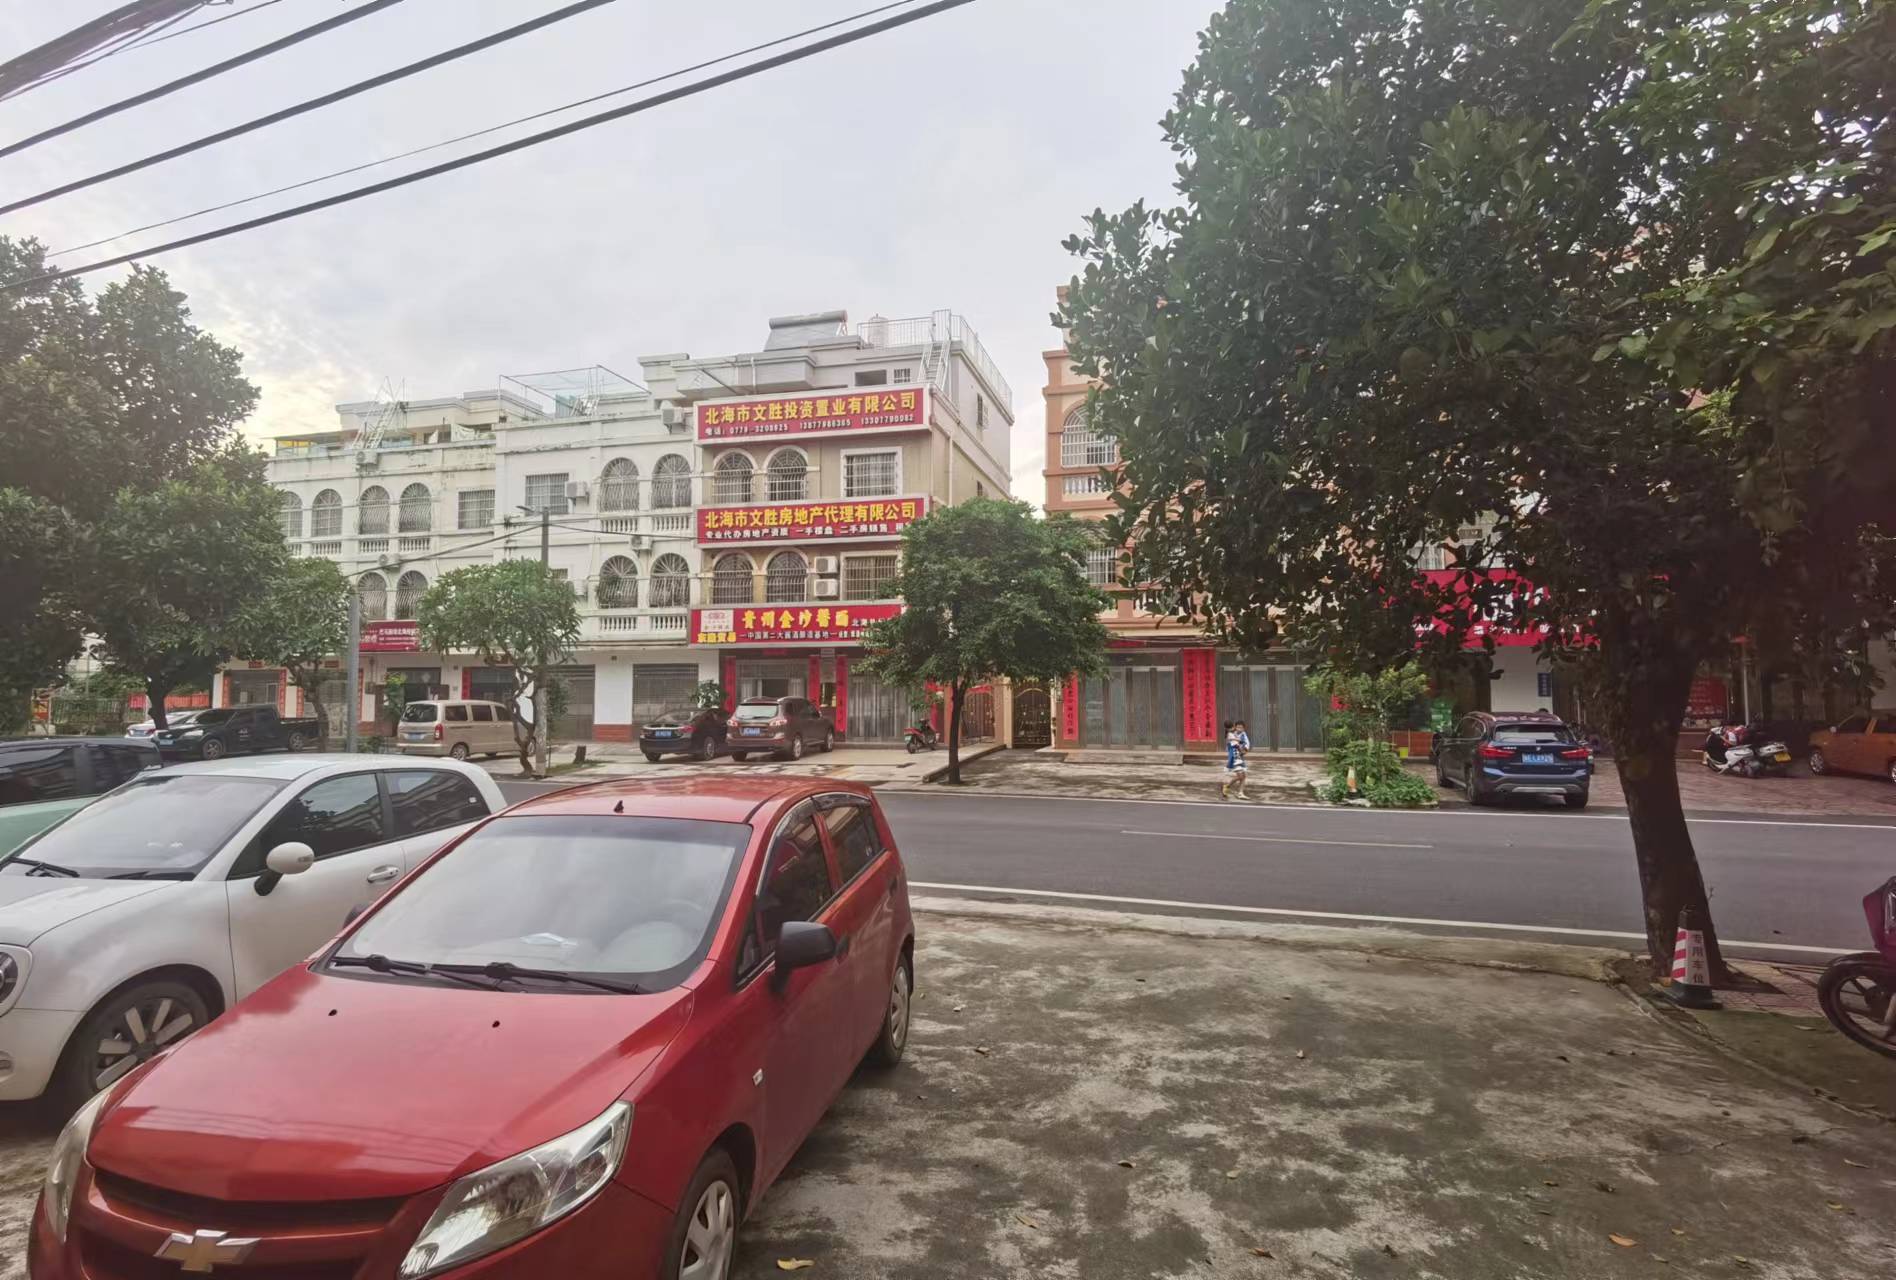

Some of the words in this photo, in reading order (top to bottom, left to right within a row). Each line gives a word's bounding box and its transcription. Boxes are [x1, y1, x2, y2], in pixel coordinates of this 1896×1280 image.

[705, 391, 915, 424] 北海市文胜投资置业有限公司
[705, 501, 915, 528] 北海市文胜房地产代理有限公司
[1691, 934, 1704, 984] 专用车位
